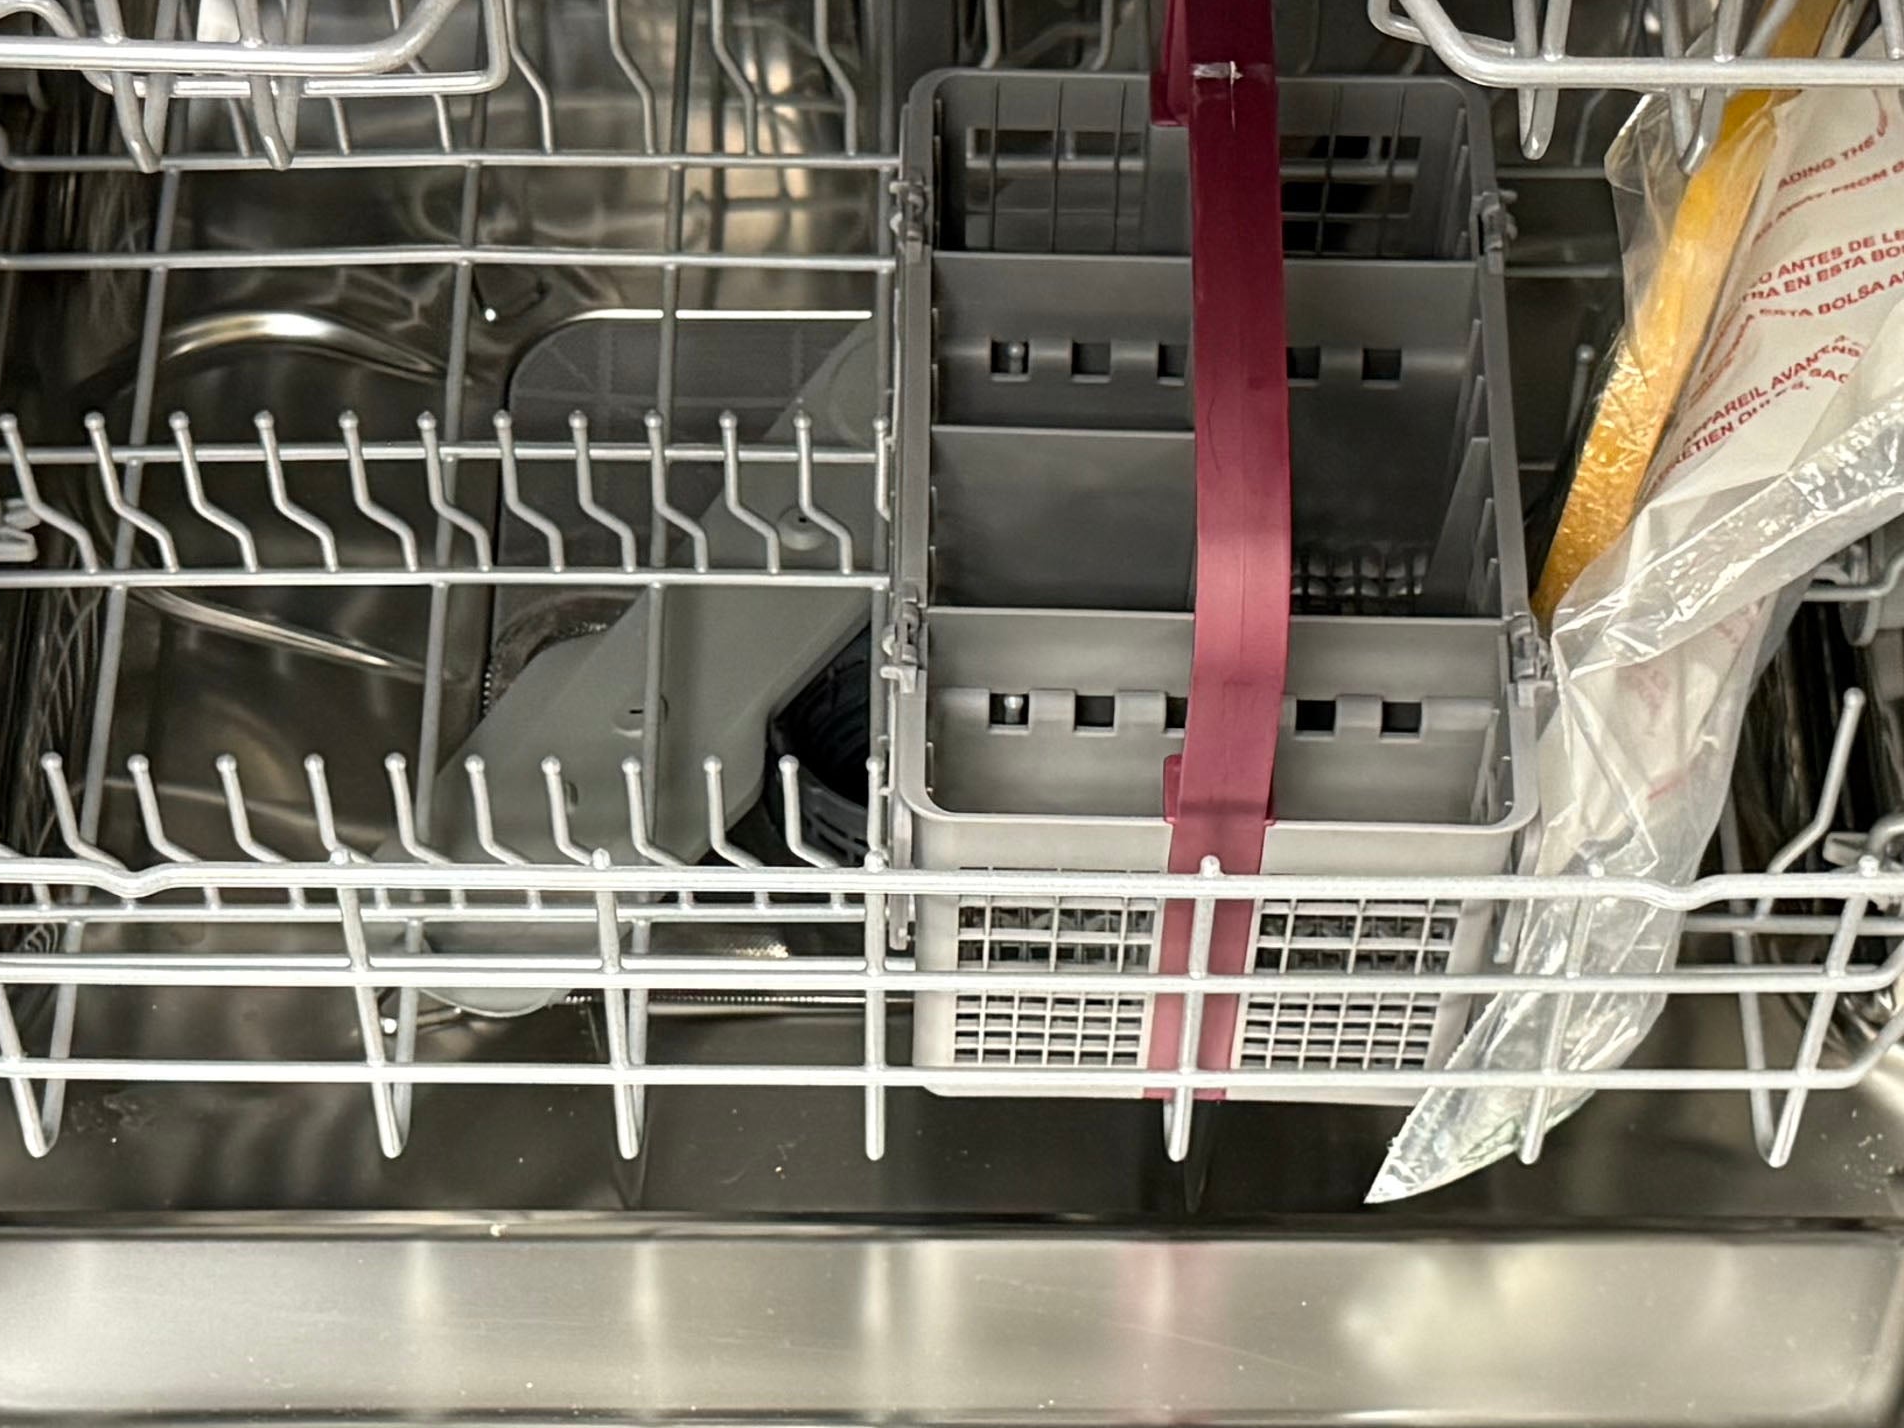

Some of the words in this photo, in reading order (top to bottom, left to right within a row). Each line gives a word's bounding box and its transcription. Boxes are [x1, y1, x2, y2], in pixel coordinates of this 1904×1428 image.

[1777, 245, 1844, 279] ANTES
[1848, 235, 1876, 254] DE
[1784, 274, 1812, 293] EN
[1816, 254, 1868, 283] ESTA
[1817, 281, 1885, 315] BOLSA
